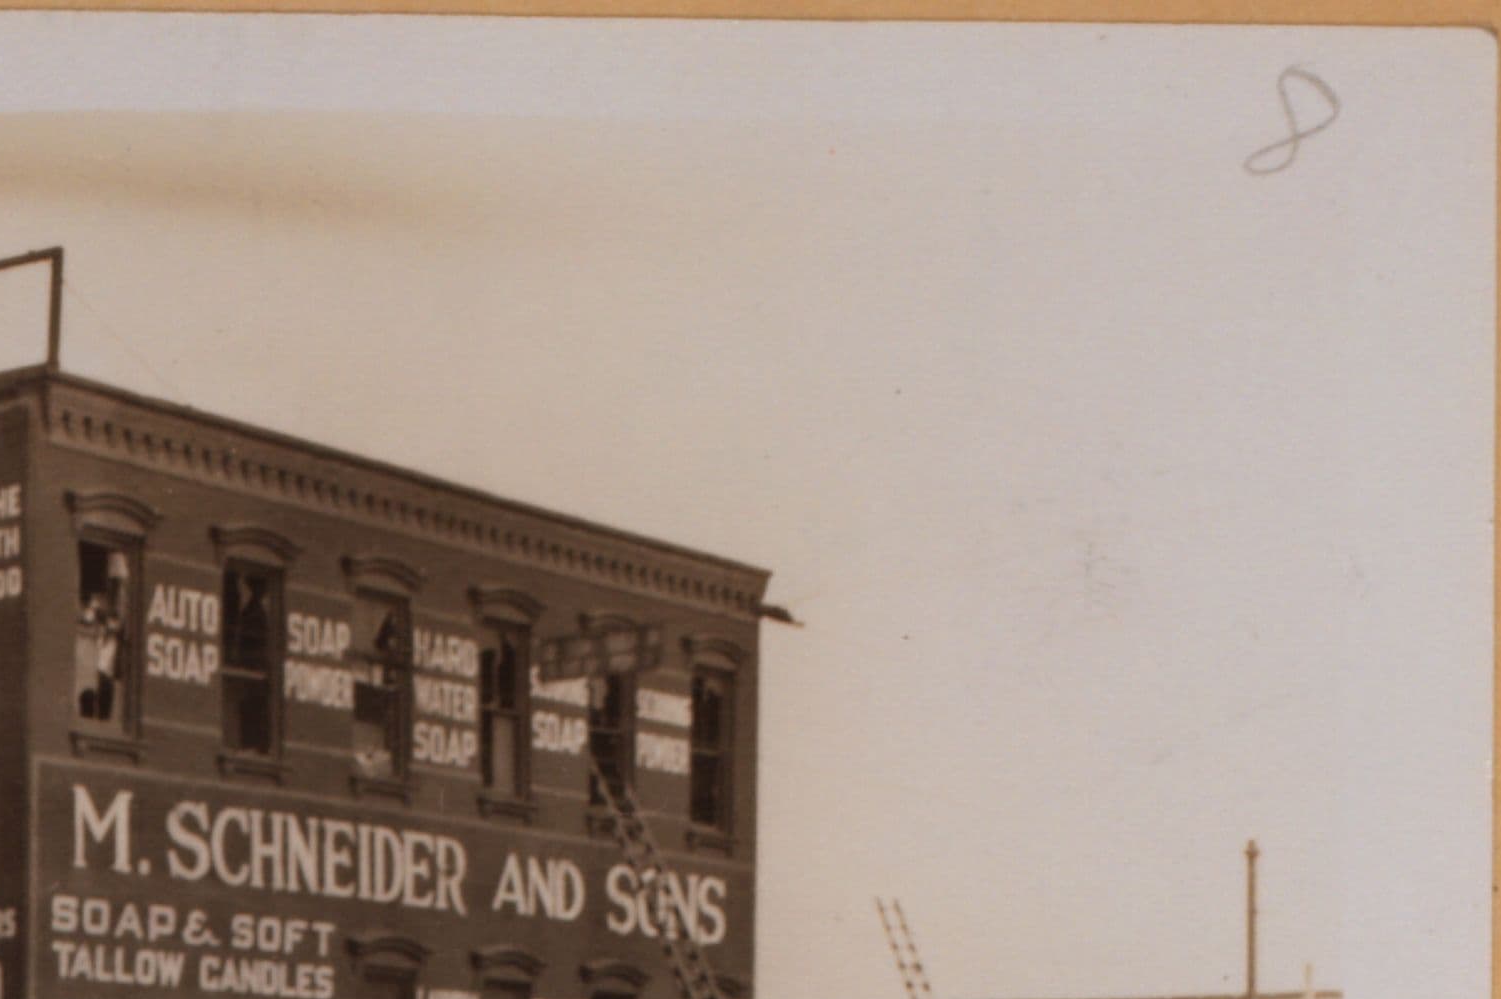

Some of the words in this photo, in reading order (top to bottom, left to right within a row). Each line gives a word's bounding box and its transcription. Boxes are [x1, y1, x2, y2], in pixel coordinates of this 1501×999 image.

[150, 584, 220, 635] AUTO
[147, 632, 219, 685] SOAP
[287, 612, 350, 660] SOAP
[413, 628, 477, 677] HARD
[413, 673, 477, 722] WATER
[413, 720, 477, 768] SOAP
[531, 710, 588, 754] SOAP
[72, 783, 151, 876] M.
[166, 800, 468, 917] SCHNEIDER
[493, 852, 586, 921] AND
[606, 863, 727, 944] SONS
[51, 895, 177, 942] SOAP
[182, 910, 220, 947] &
[231, 913, 337, 957] SOFT
[52, 940, 185, 987] TALLOW
[200, 955, 334, 999] CANDLES
